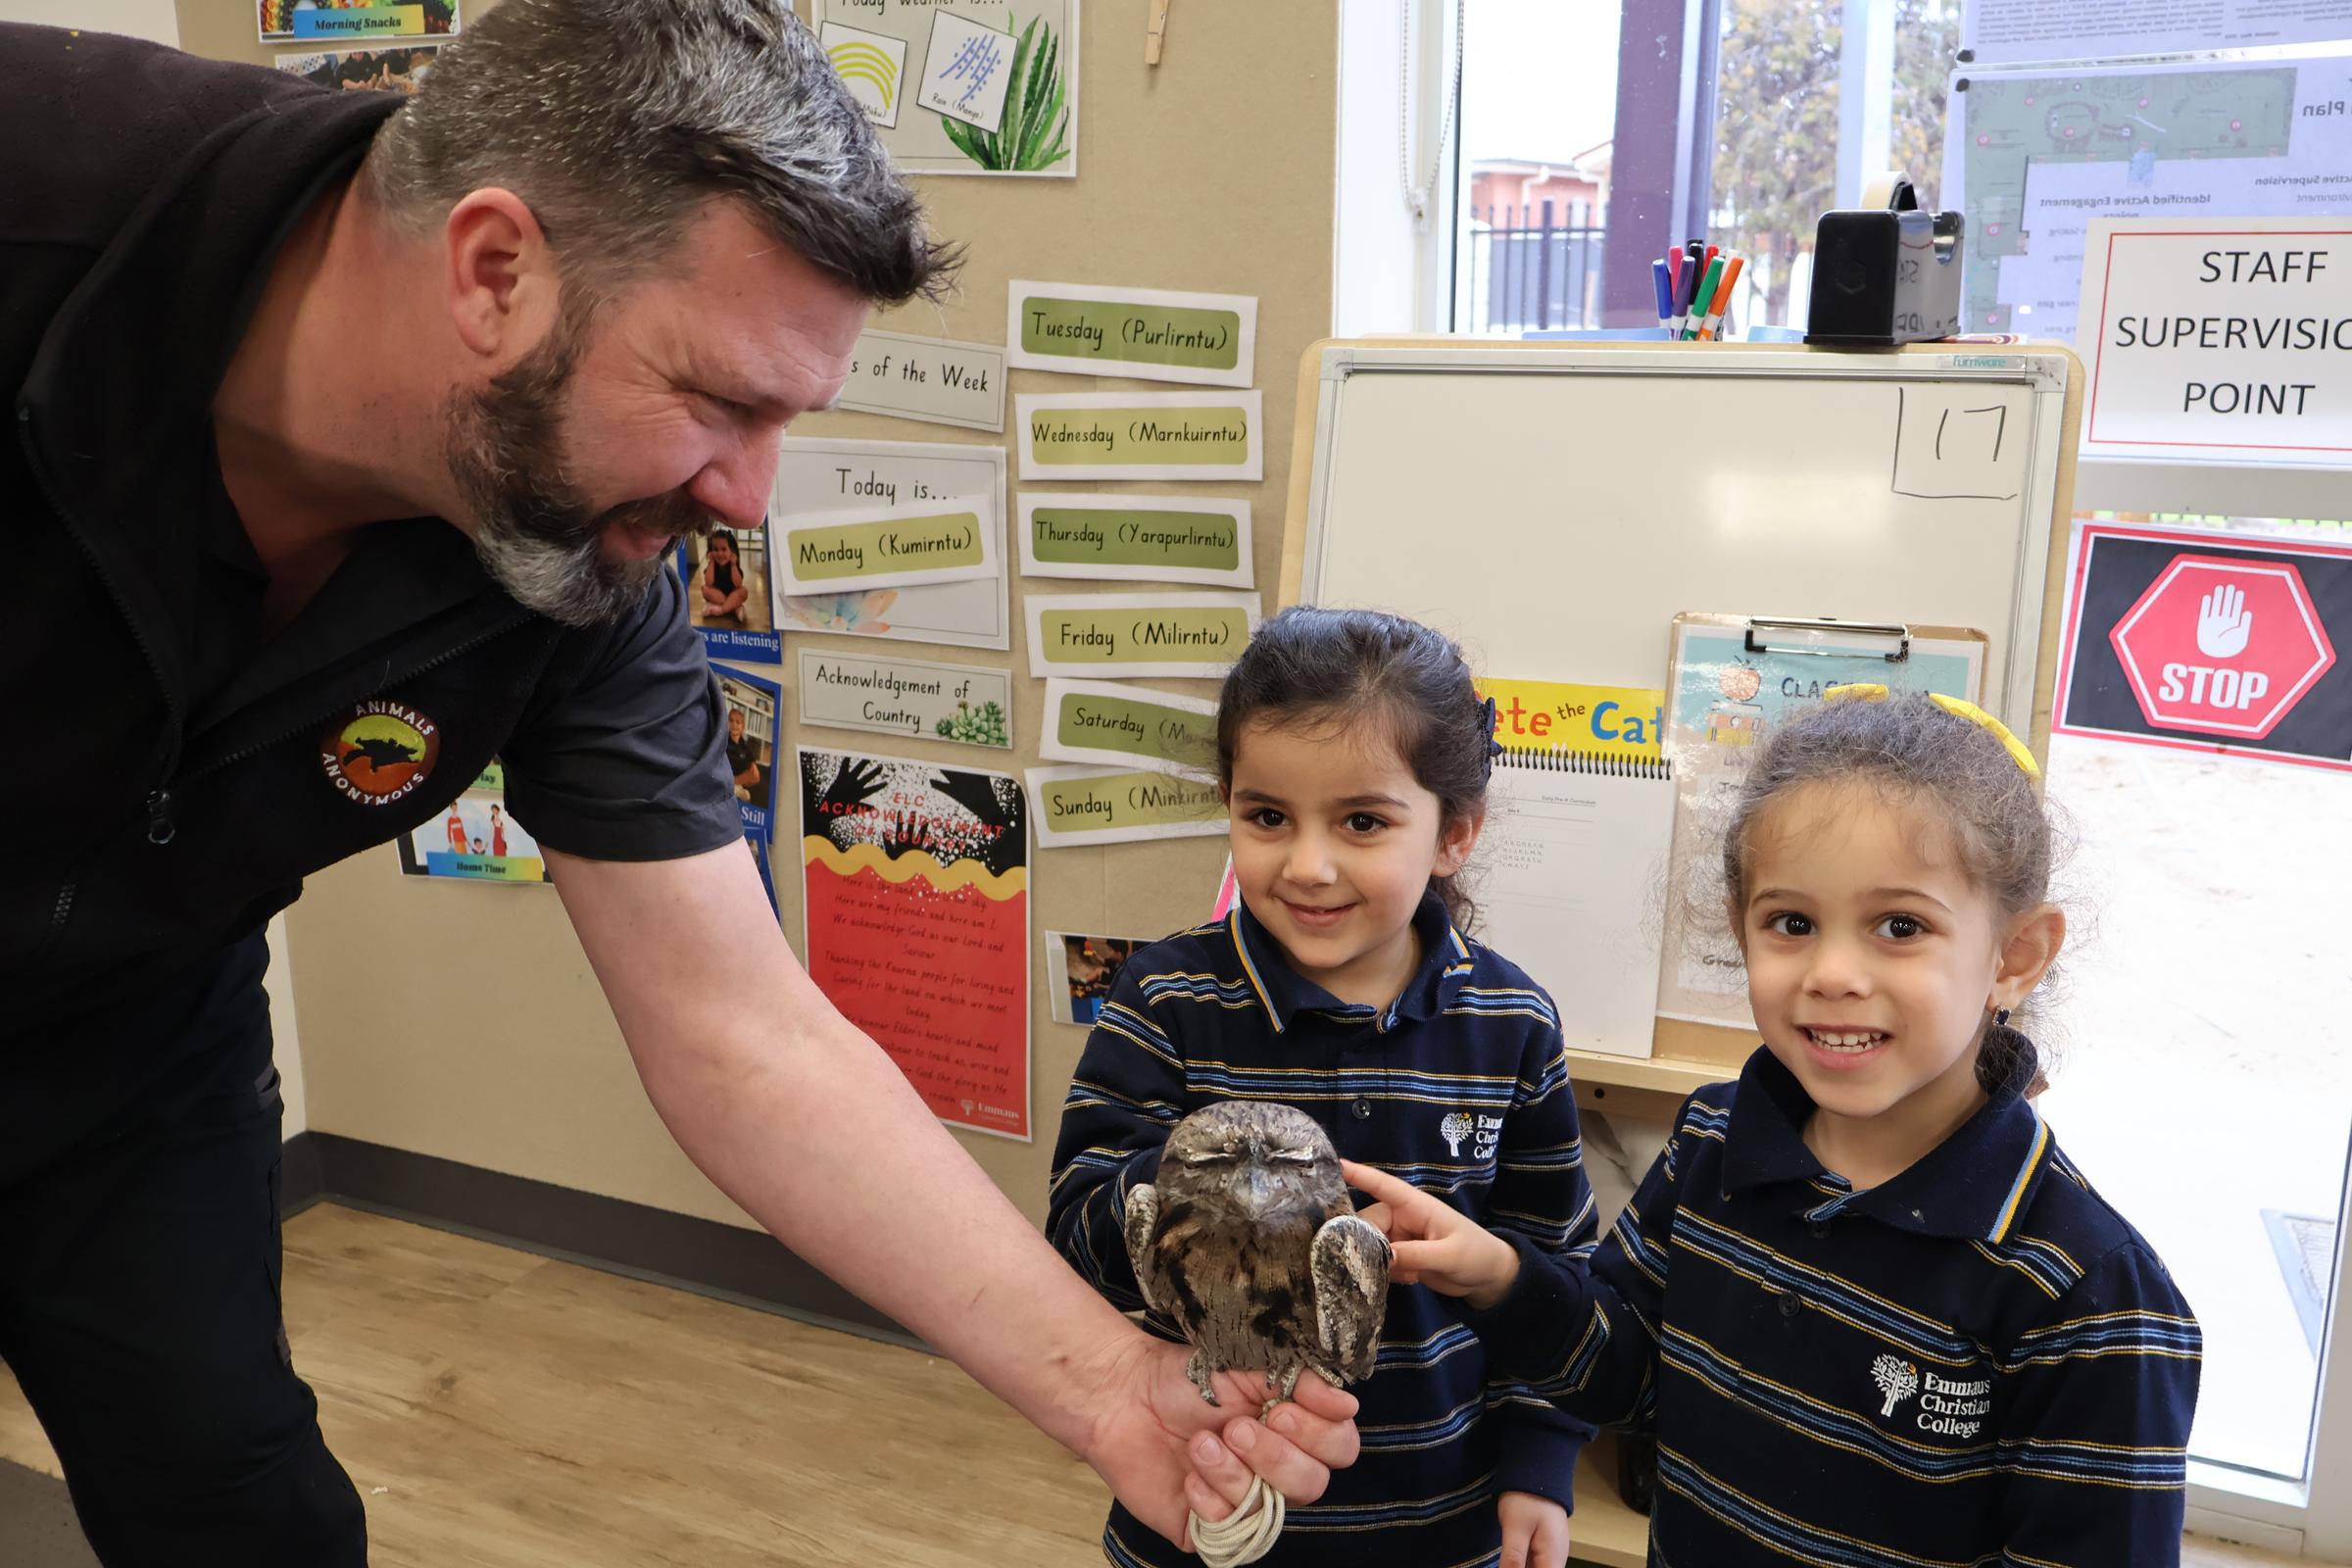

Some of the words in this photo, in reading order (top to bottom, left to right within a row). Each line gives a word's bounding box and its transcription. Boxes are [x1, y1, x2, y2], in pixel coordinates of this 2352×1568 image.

[315, 18, 362, 31] Morning
[364, 16, 402, 29] Snacks
[842, 0, 885, 16] oay
[2199, 251, 2328, 283] STAFF
[1032, 312, 1103, 351] Tuesday
[1122, 318, 1227, 351] (Purlirntu)
[873, 356, 891, 377] of
[903, 360, 925, 383] the
[942, 364, 988, 392] Week
[2183, 382, 2316, 416] POINT
[1032, 423, 1113, 451] Wednesday
[1129, 421, 1247, 442] (Marnkuirntu)
[1936, 406, 2006, 462] 17
[836, 468, 896, 506] Today
[800, 540, 862, 568] Monday
[879, 526, 971, 557] (Kumirntu)
[1036, 521, 1103, 551] Thursday
[1118, 523, 1233, 552] (Yarapurlirntu)
[711, 634, 728, 644] are
[731, 632, 779, 651] listening
[1061, 623, 1114, 656] Friday
[1132, 621, 1229, 646] (Milirntu)
[815, 664, 941, 699] Acknowledgement
[955, 680, 970, 699] of
[2158, 662, 2269, 710] STOP
[356, 701, 434, 735] ANIMALS
[863, 701, 920, 733] Country
[1074, 708, 1145, 742] Saturday
[1556, 703, 1586, 720] the
[322, 753, 423, 806] ANONYMOUS
[741, 807, 764, 825] Still
[894, 792, 925, 808] ELC
[1054, 793, 1112, 822] Sunday
[819, 801, 1004, 839] ACKNOWLEDGEMENT
[457, 861, 482, 871] Home
[484, 863, 507, 873] Time
[835, 894, 855, 905] Here
[877, 904, 890, 915] my
[929, 910, 945, 921] and
[949, 911, 968, 924] here
[833, 912, 847, 924] We
[851, 916, 904, 938] acknowledge
[909, 925, 925, 938] God
[943, 933, 958, 943] our
[962, 934, 983, 949] Lord
[987, 941, 1004, 953] and
[825, 950, 864, 971] Thanking
[868, 958, 881, 970] the
[921, 969, 947, 983] people
[951, 972, 965, 987] for
[998, 985, 1015, 996] and
[866, 975, 880, 990] for
[884, 981, 898, 993] the
[902, 984, 919, 997] land
[940, 992, 965, 1005] which
[956, 1037, 972, 1048] and
[1924, 1372, 1991, 1396] Emmaus
[1921, 1394, 1990, 1415] Christian
[1917, 1413, 1981, 1439] College
